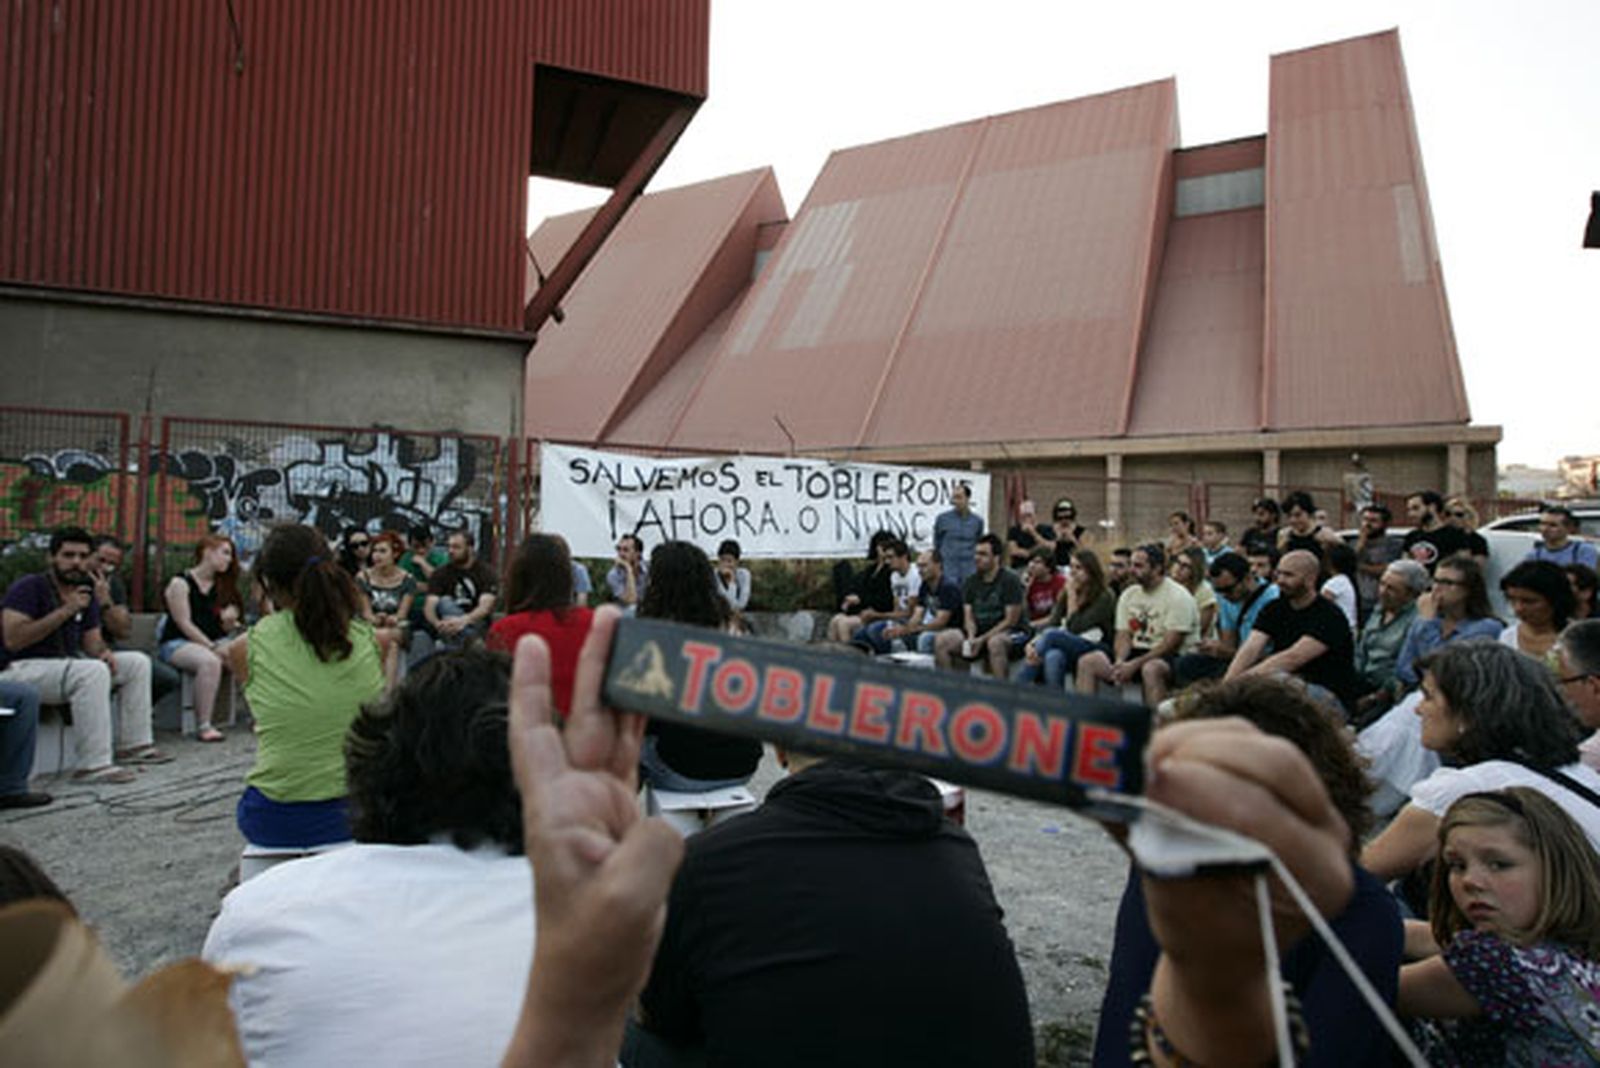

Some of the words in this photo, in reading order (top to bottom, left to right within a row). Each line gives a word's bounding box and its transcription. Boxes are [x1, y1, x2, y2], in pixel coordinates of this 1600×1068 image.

[569, 458, 740, 493] SALVEMOS
[756, 471, 782, 487] EL
[799, 505, 820, 534] O
[835, 505, 928, 541] NUNC
[680, 640, 1127, 787] TOBLERONE
